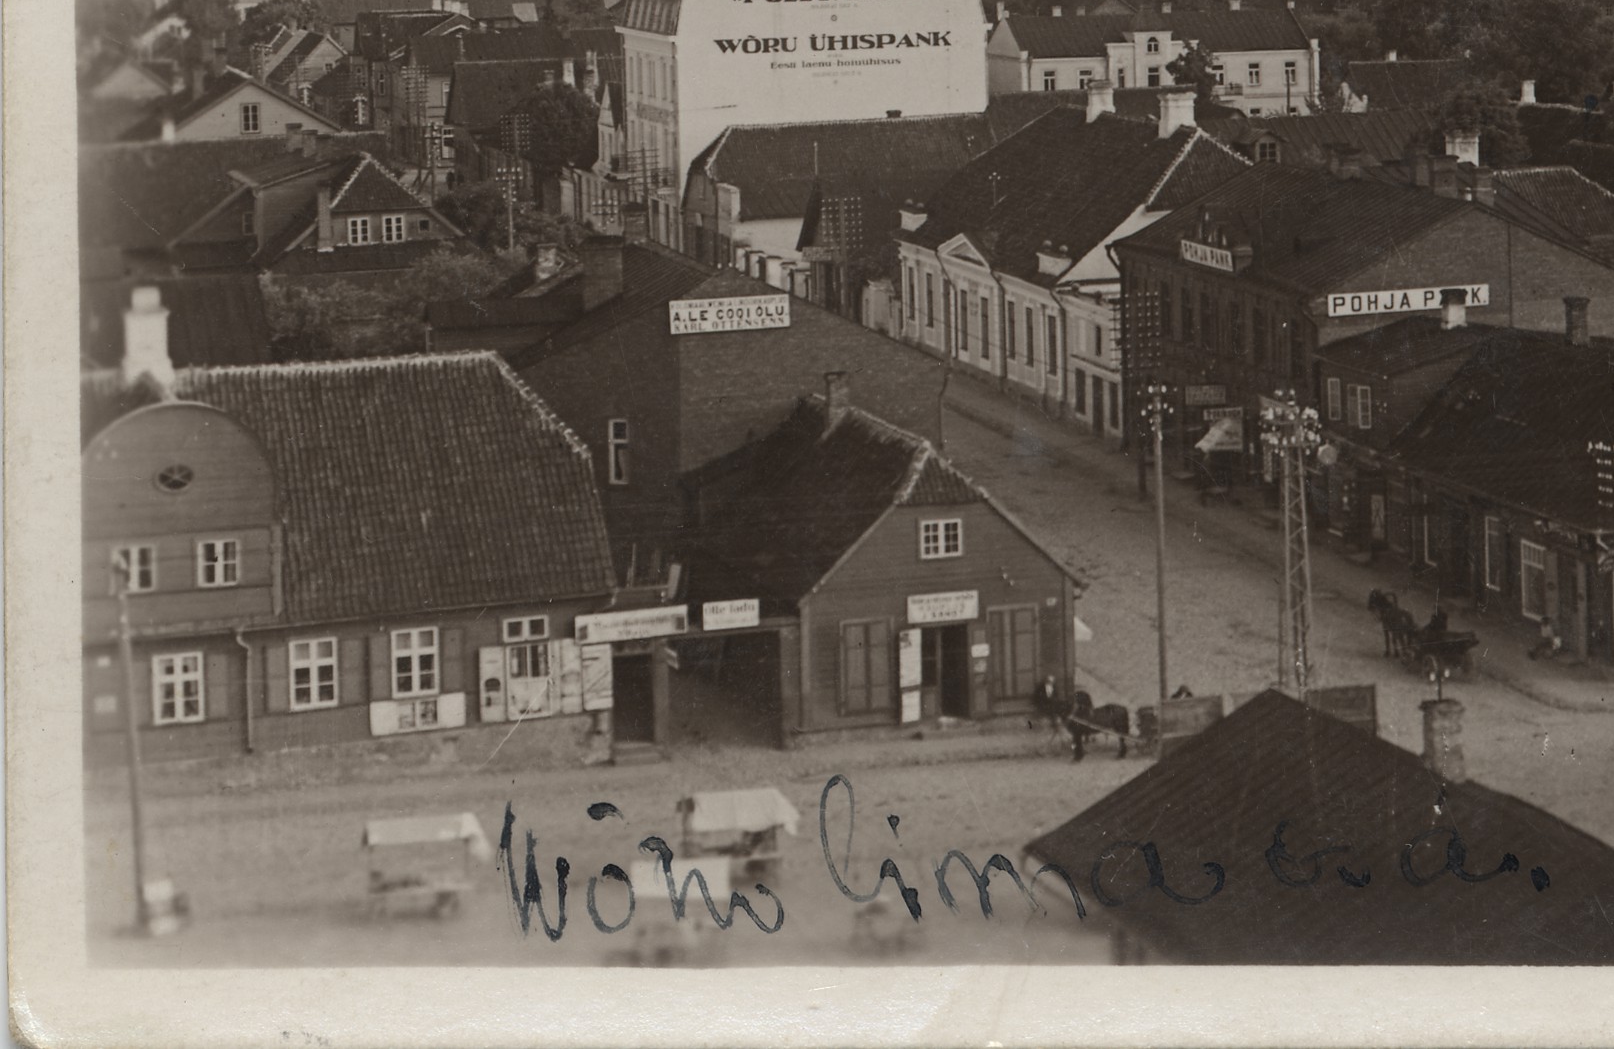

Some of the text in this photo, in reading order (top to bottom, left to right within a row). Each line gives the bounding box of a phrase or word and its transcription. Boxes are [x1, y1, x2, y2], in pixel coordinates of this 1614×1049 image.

[713, 31, 951, 54] WÕRU ÜHISPANK
[1333, 287, 1487, 313] POHJA PK.
